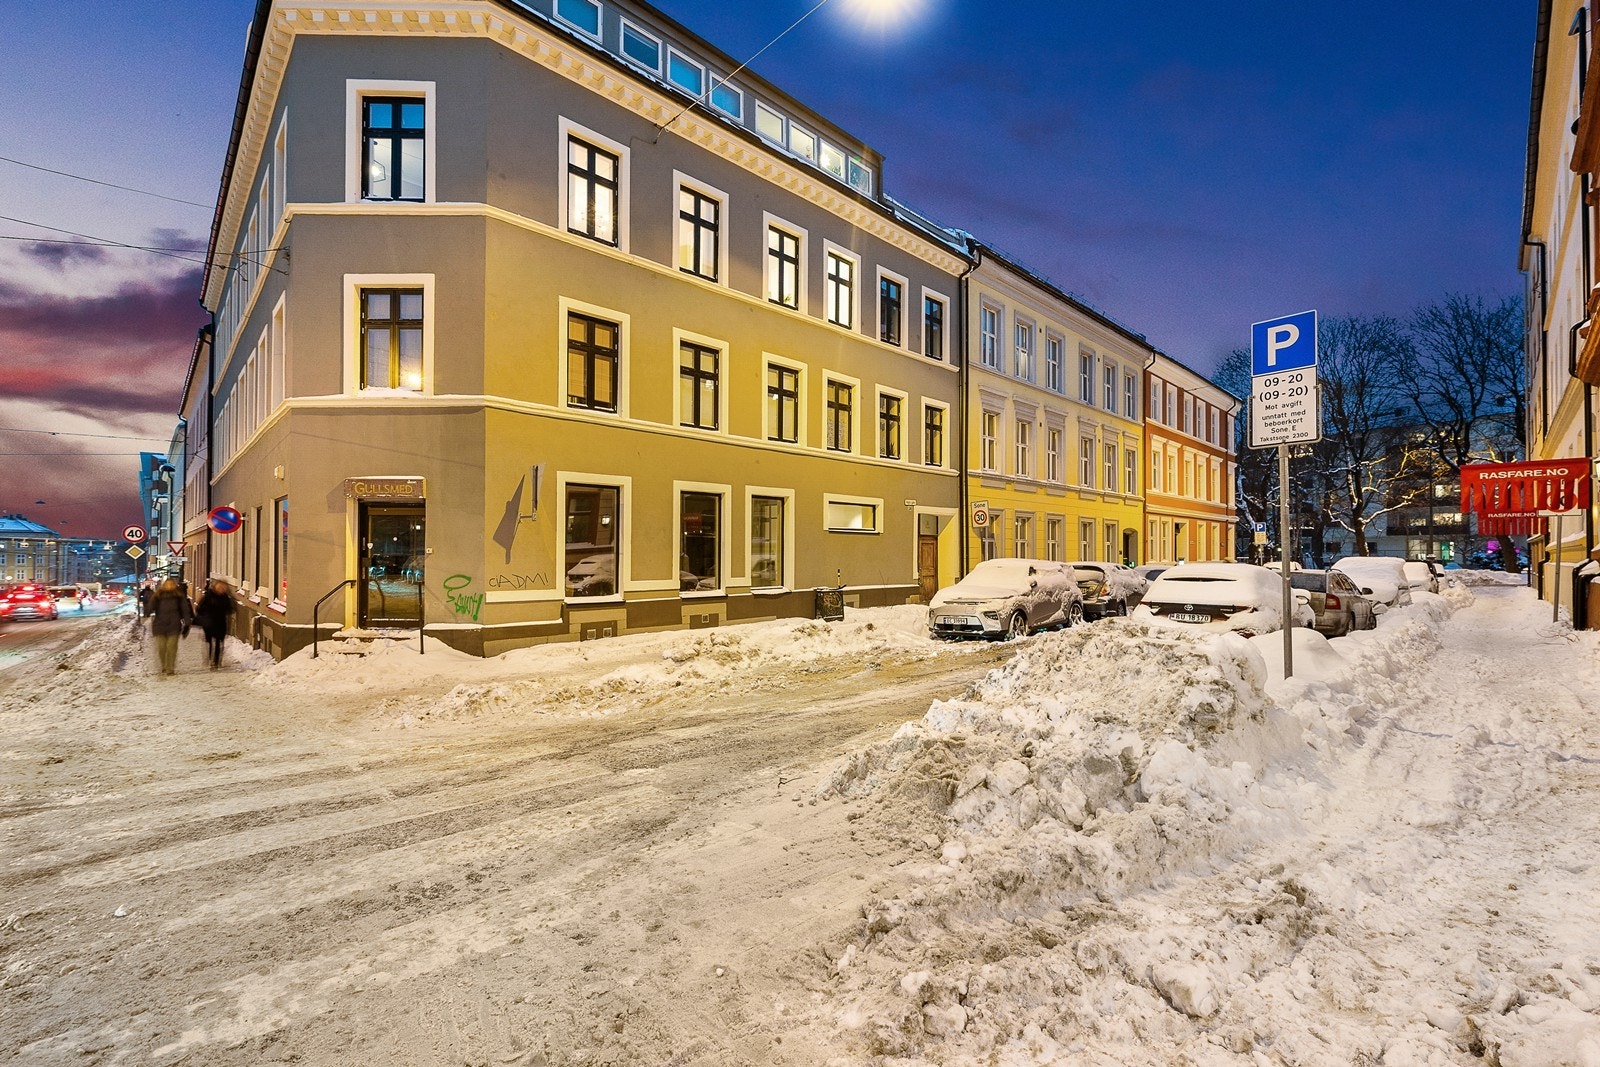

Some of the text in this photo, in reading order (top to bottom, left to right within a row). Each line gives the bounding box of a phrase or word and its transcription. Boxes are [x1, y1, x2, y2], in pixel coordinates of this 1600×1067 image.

[1267, 324, 1299, 367] P
[1281, 400, 1302, 409] avgift
[1261, 409, 1306, 421] unntatt med
[1264, 418, 1303, 427] beboerkort
[1292, 431, 1309, 439] 2300
[1480, 468, 1568, 479] RASFARE.NO
[354, 482, 413, 494] GULLSMED
[1257, 523, 1264, 531] P
[127, 530, 142, 538] 40
